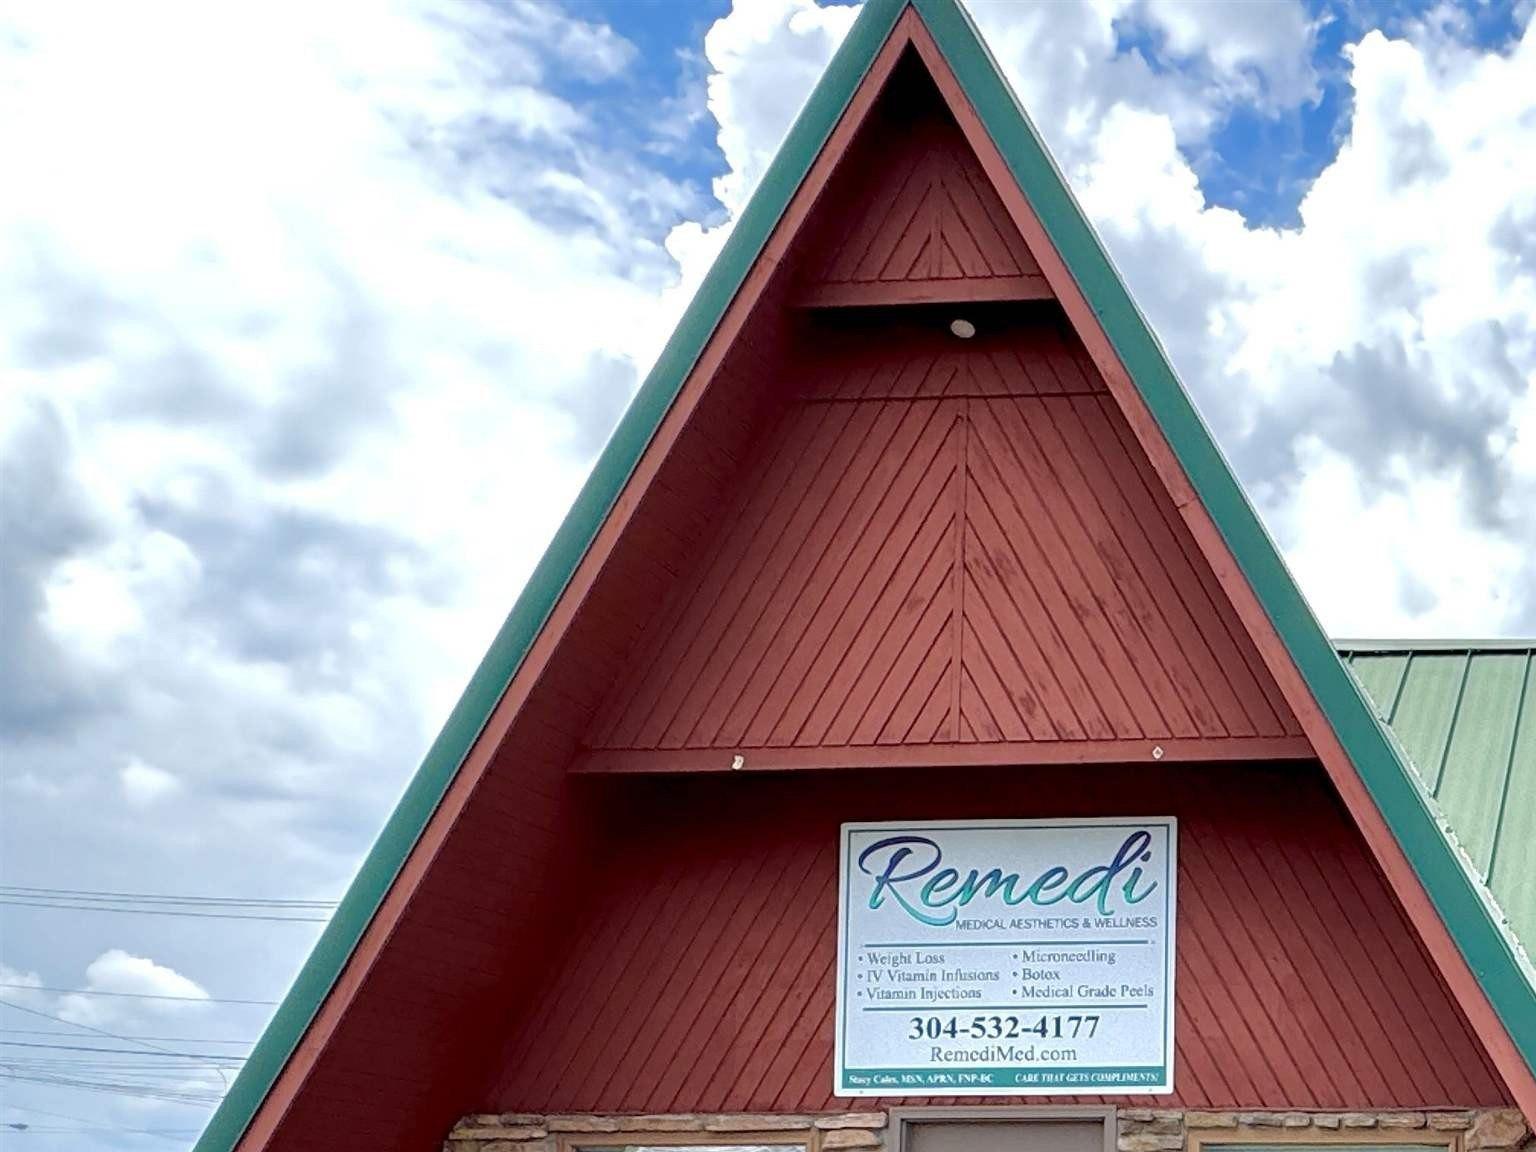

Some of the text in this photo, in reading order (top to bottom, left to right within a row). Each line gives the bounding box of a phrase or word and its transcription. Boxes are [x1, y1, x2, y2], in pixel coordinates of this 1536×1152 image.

[858, 830, 1158, 927] Remedi
[956, 917, 1158, 930] MEDICAL AESTHETICS & WELLNESS
[866, 951, 945, 967] Weight Loss
[1022, 949, 1116, 965] Microneedling
[867, 968, 1000, 982] IV Vitamin Infusions
[1022, 968, 1061, 981] Botox
[866, 986, 982, 1003] Vitamin Injections
[1022, 984, 1154, 998] Medical Grade Peels
[908, 1015, 1100, 1040] 304-532-4177
[930, 1045, 1077, 1062] RemediMed.com
[1015, 1072, 1039, 1083] CARE
[1041, 1072, 1065, 1083] THAT
[1066, 1072, 1090, 1083] GETS
